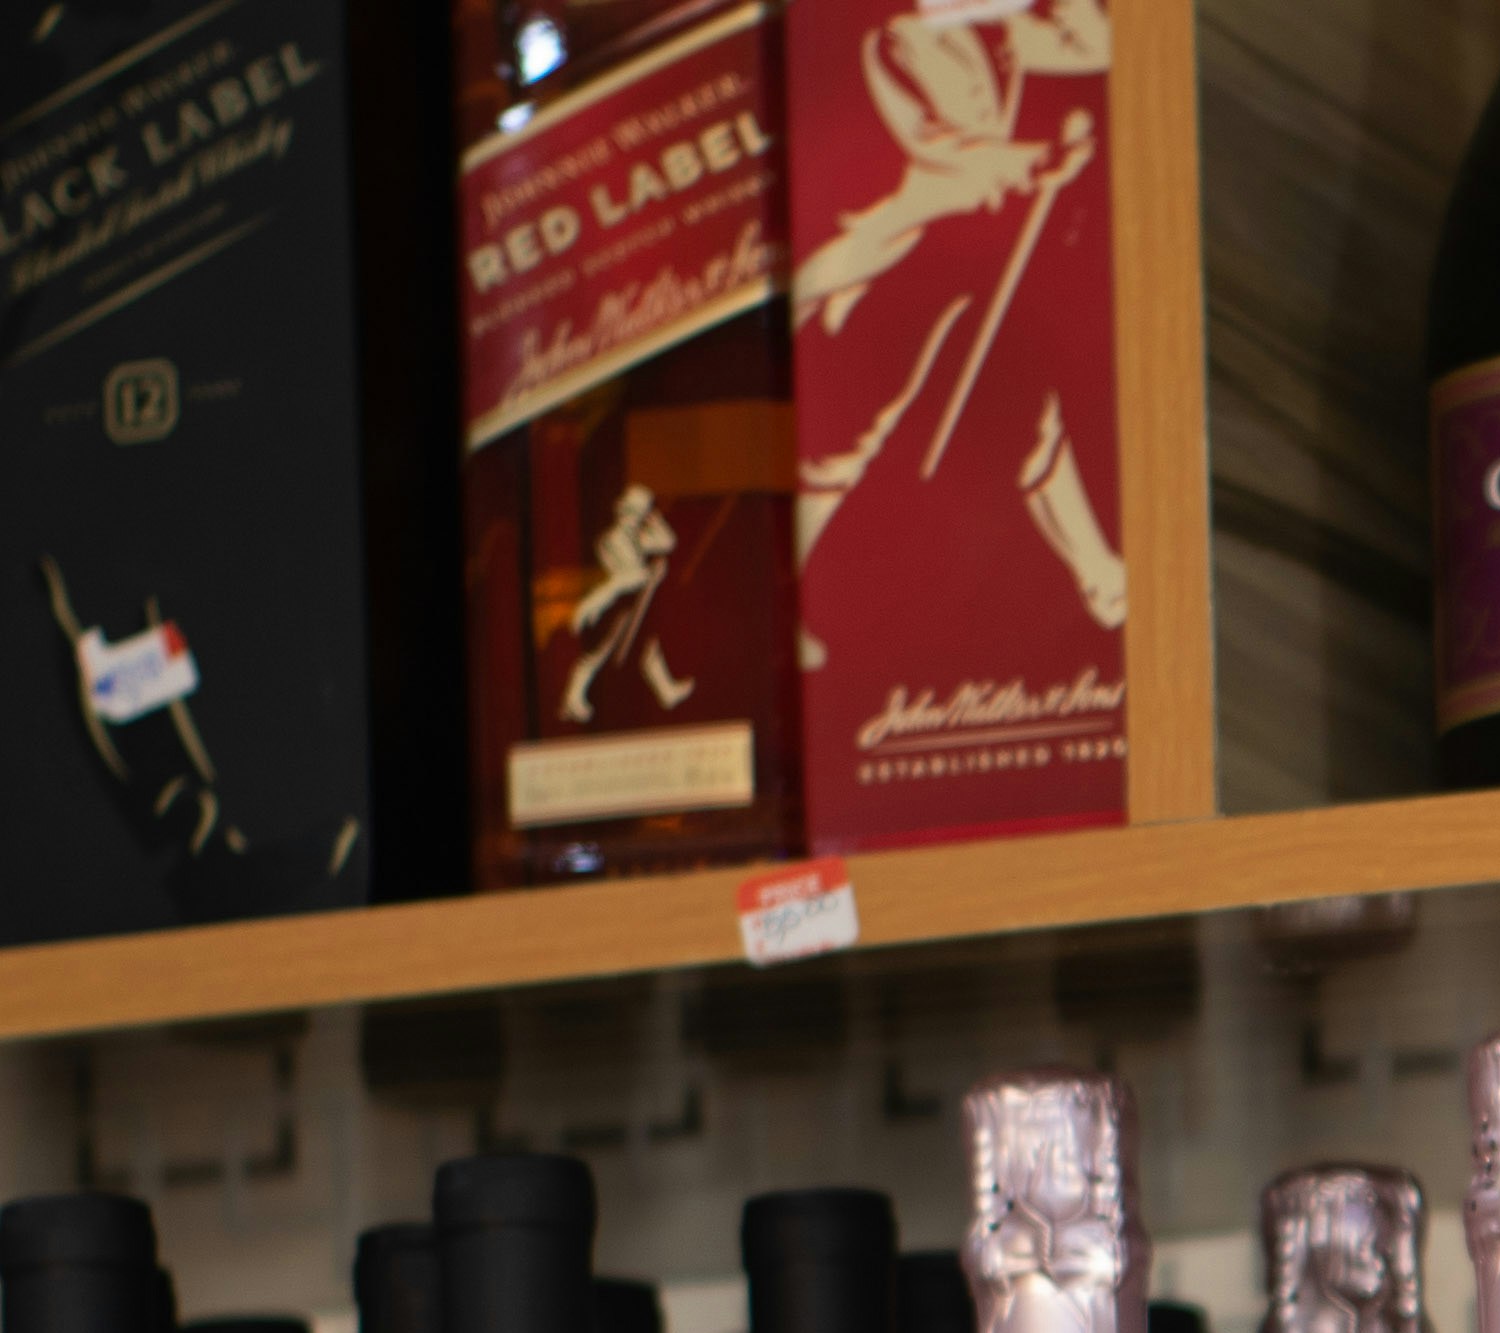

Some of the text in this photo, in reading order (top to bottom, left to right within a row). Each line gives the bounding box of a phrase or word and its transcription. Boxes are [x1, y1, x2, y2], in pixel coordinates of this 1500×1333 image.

[0, 147, 128, 255] LACK
[142, 42, 320, 165] LABEL
[467, 206, 580, 292] RED
[590, 111, 772, 229] LABEL
[121, 379, 164, 426] 12
[857, 744, 1051, 784] ESTABLISHED
[756, 874, 823, 906] PRICE
